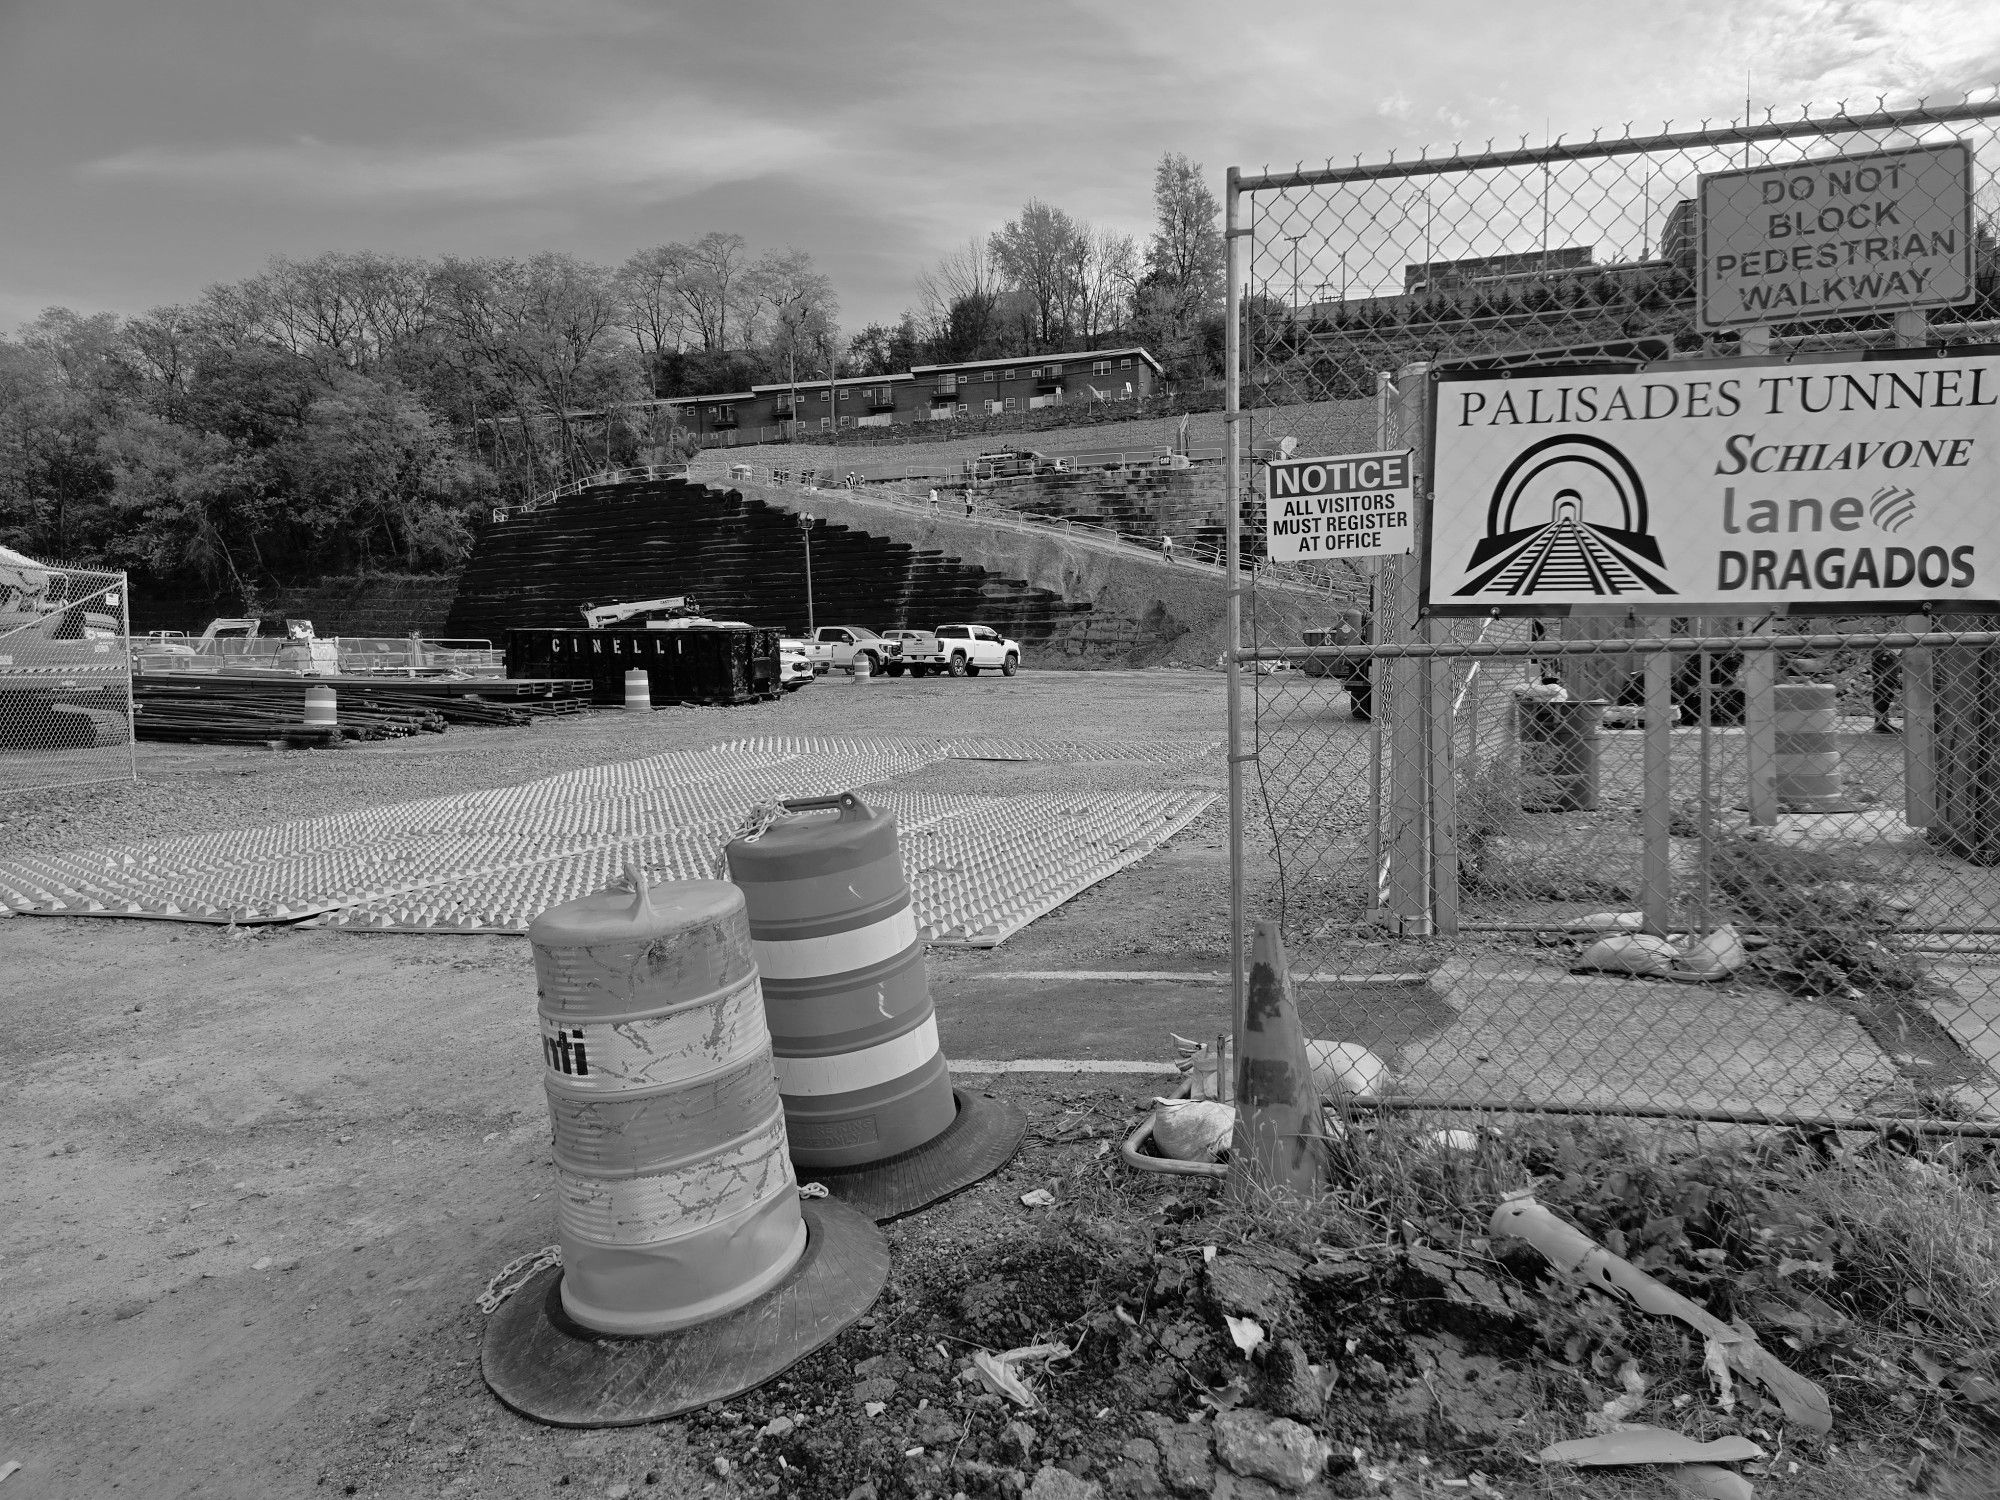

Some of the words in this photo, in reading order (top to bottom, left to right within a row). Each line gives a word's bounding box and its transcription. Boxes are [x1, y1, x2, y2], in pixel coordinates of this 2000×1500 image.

[1762, 176, 1815, 204] DO
[1828, 163, 1906, 197] NOT
[1769, 201, 1901, 239] BLOCK
[1717, 230, 1955, 280] PEDESTRIAN
[1739, 267, 1932, 311] WALKWAY
[1458, 379, 1741, 427] PALISADES
[1759, 368, 1999, 415] TUNNEL
[1714, 433, 1975, 476] SCHIAVONE
[1276, 458, 1402, 495] NOTICE
[1273, 517, 1322, 535] MUST
[1327, 511, 1408, 532] REGISTER
[1284, 500, 1313, 517] ALL
[1317, 493, 1395, 514] VISITORS
[1723, 486, 1864, 534] lane
[1299, 536, 1320, 552] AT
[1325, 532, 1382, 551] OFFICE
[1717, 545, 1975, 591] DRAGADOS
[552, 638, 683, 655] CINELLI
